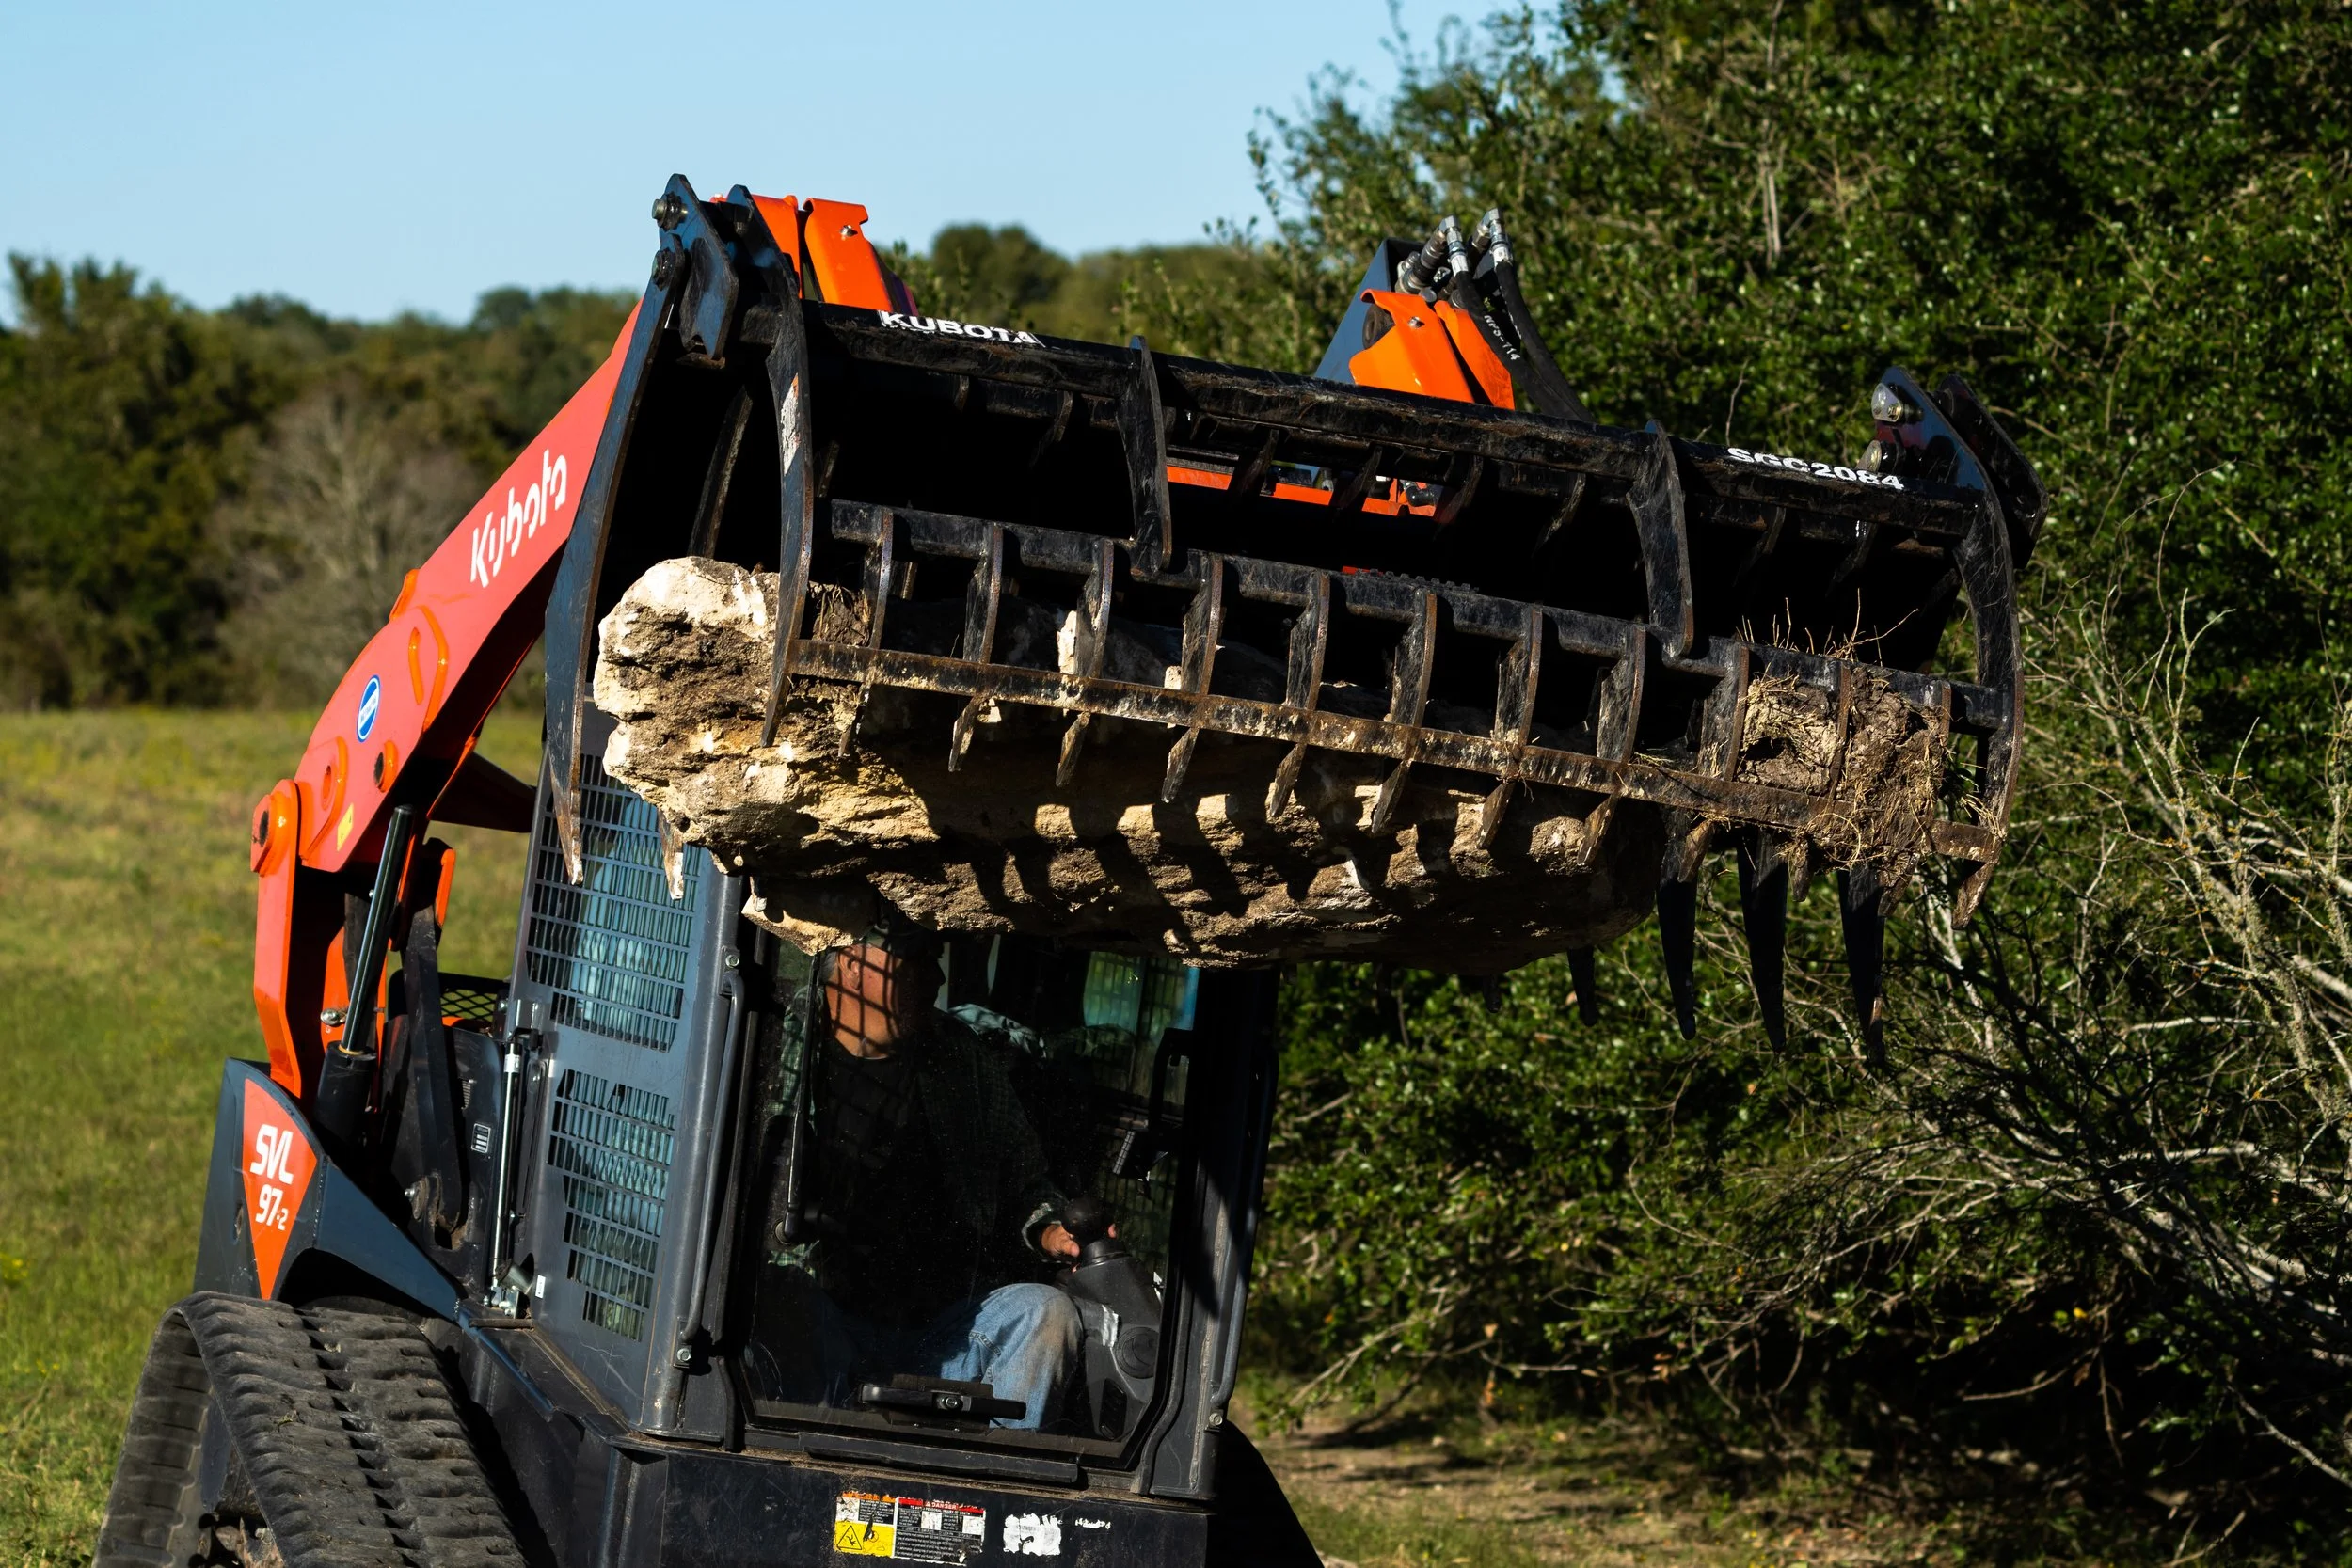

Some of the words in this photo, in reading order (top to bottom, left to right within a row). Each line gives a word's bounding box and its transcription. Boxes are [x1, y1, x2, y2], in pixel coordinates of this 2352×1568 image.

[877, 309, 1038, 344] KUBOTA
[1727, 447, 1904, 490] SGC2084
[470, 449, 567, 588] Kubota
[250, 1124, 294, 1185] SVL
[255, 1184, 289, 1230] 97-2
[931, 1502, 958, 1511] DANGER
